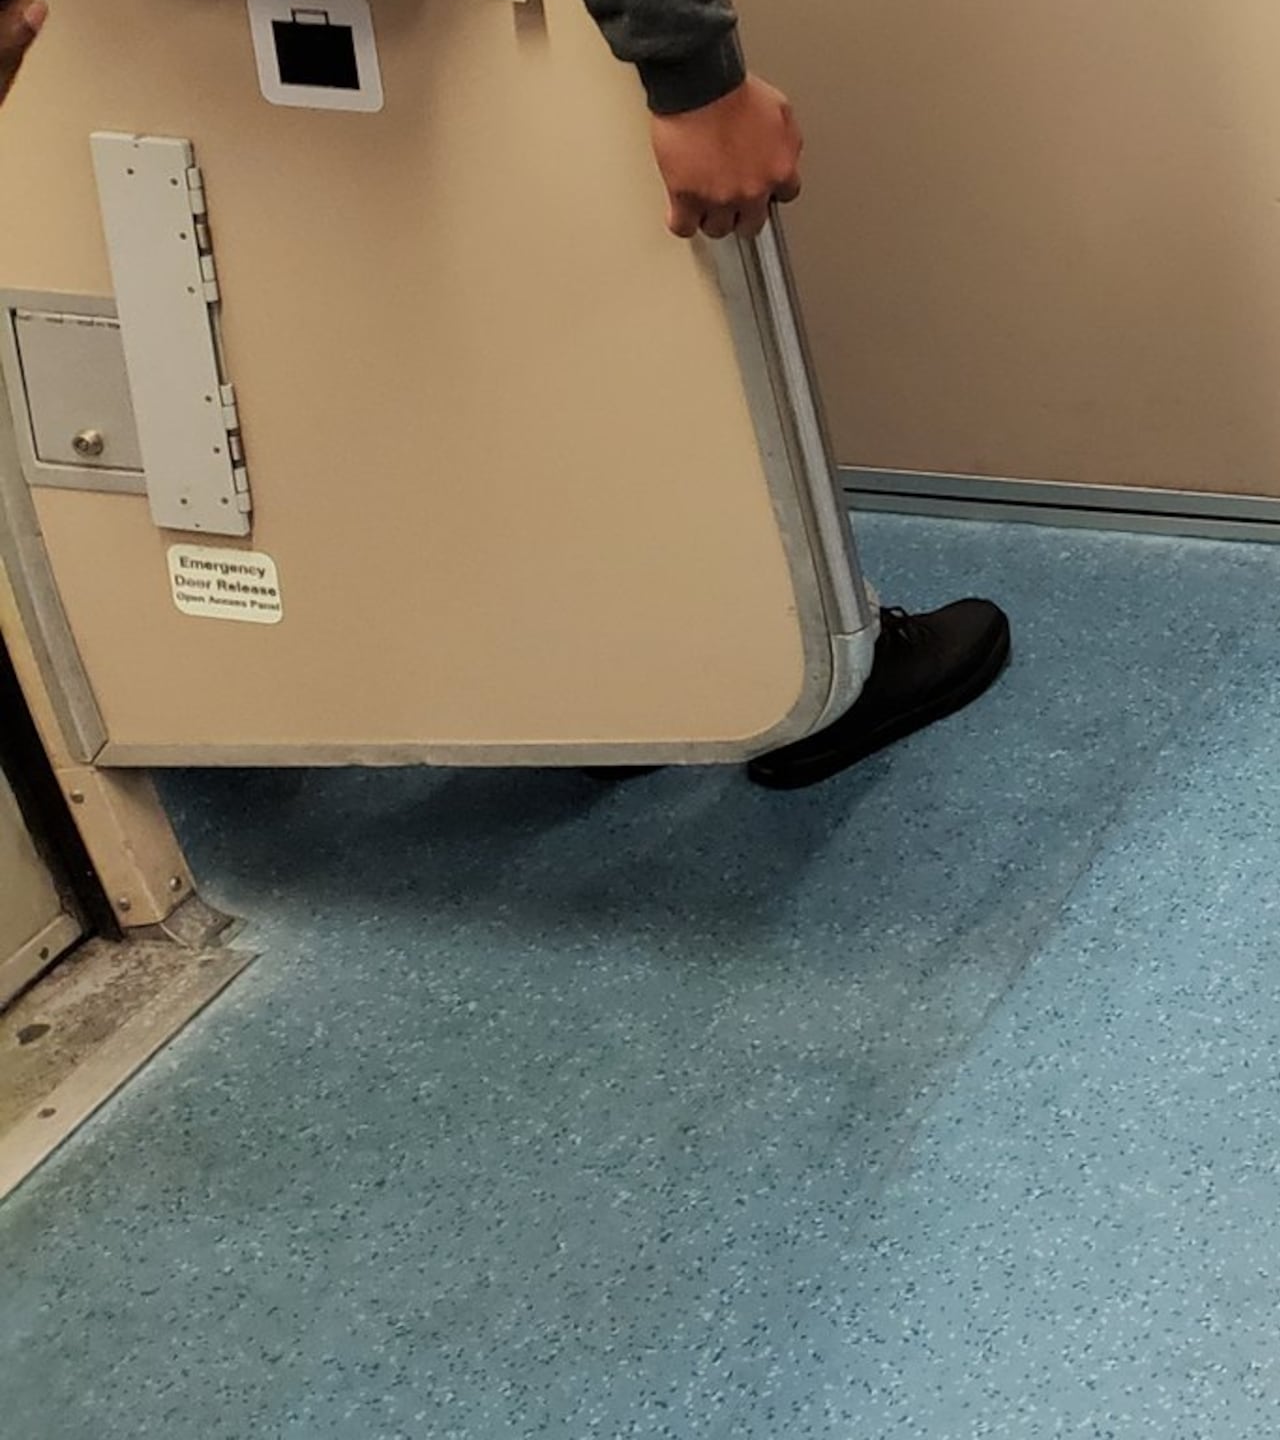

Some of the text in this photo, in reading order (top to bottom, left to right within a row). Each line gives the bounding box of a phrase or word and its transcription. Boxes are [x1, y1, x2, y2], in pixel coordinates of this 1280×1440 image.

[178, 555, 266, 578] Emergency
[174, 574, 277, 597] Door Release
[176, 591, 206, 604] Open
[208, 595, 248, 608] Access
